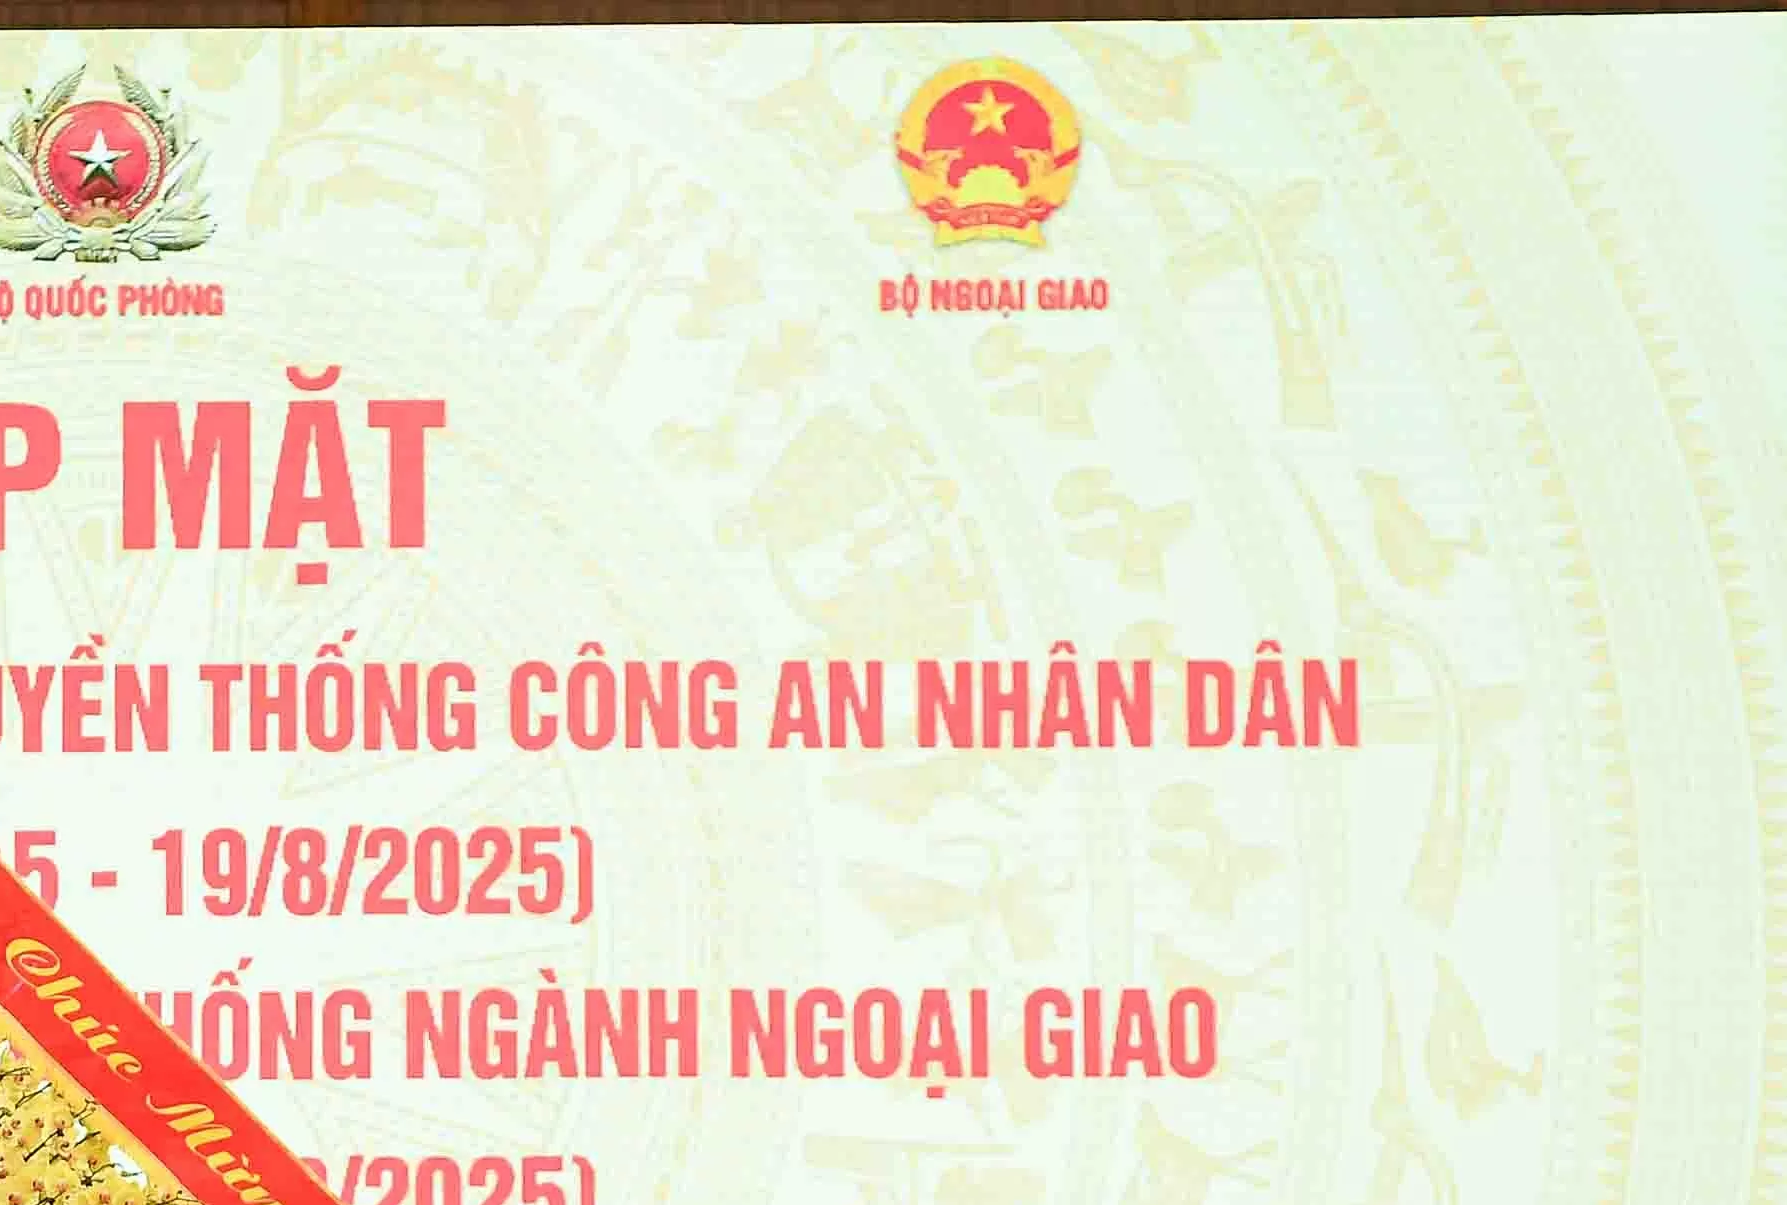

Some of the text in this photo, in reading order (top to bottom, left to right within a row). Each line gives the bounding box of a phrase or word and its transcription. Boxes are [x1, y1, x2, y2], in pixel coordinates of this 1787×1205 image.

[24, 273, 108, 319] QUỐC
[117, 278, 226, 317] PHÒNG
[879, 272, 1111, 318] BỘ NGOẠI GIAO
[122, 364, 446, 585] MẶT
[199, 629, 476, 753] THỐNG
[509, 641, 737, 752] CÔNG
[767, 660, 884, 749] AN
[917, 640, 1153, 749] NHÂN
[1186, 639, 1360, 748] DÂN
[152, 825, 594, 924] 19/8/2025)
[5, 936, 144, 1083] Chúc
[405, 968, 699, 1080] NGÀNH
[729, 987, 989, 1099] NGOẠI
[1023, 987, 1217, 1079] GIAO
